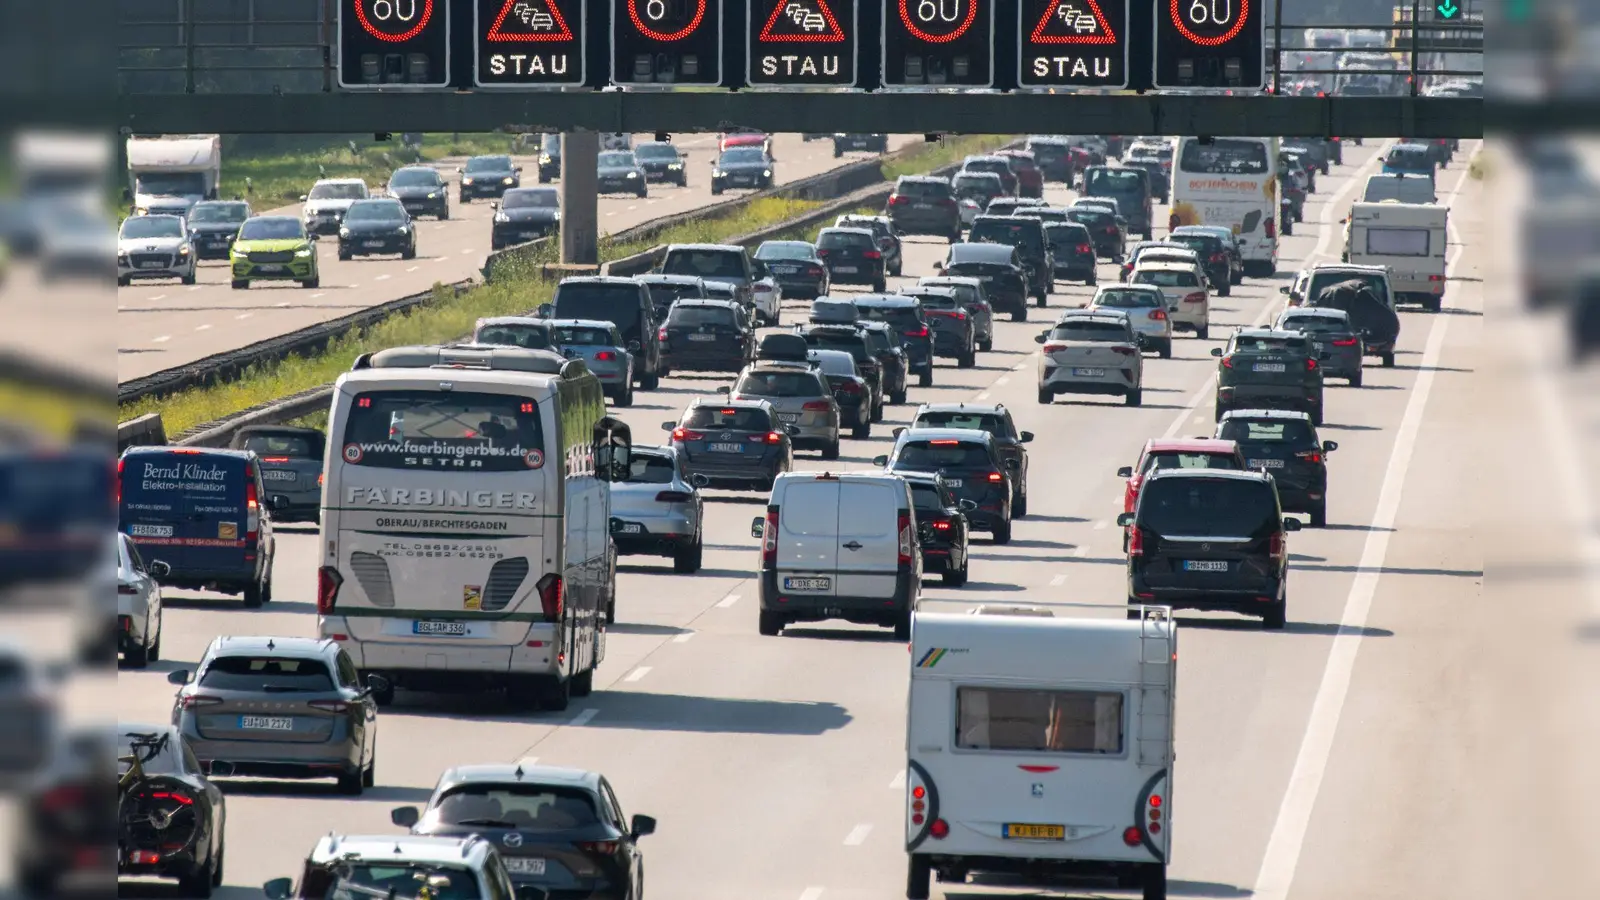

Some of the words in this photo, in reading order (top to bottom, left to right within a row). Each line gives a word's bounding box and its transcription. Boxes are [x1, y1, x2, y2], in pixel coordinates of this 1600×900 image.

[918, 0, 959, 22] 60
[1189, 0, 1230, 24] 60
[490, 54, 567, 75] STAU
[762, 55, 839, 76] STAU
[1033, 56, 1110, 77] STAU
[348, 449, 358, 458] 80
[360, 441, 528, 458] www.faerbingerbus.de
[528, 454, 540, 463] 100
[404, 457, 483, 467] SETRA
[143, 462, 181, 478] Bernd
[183, 463, 227, 481] Klinder
[142, 480, 226, 492] Elektro-Installation
[376, 517, 508, 530] OBERAU/BERCHTESGADEN
